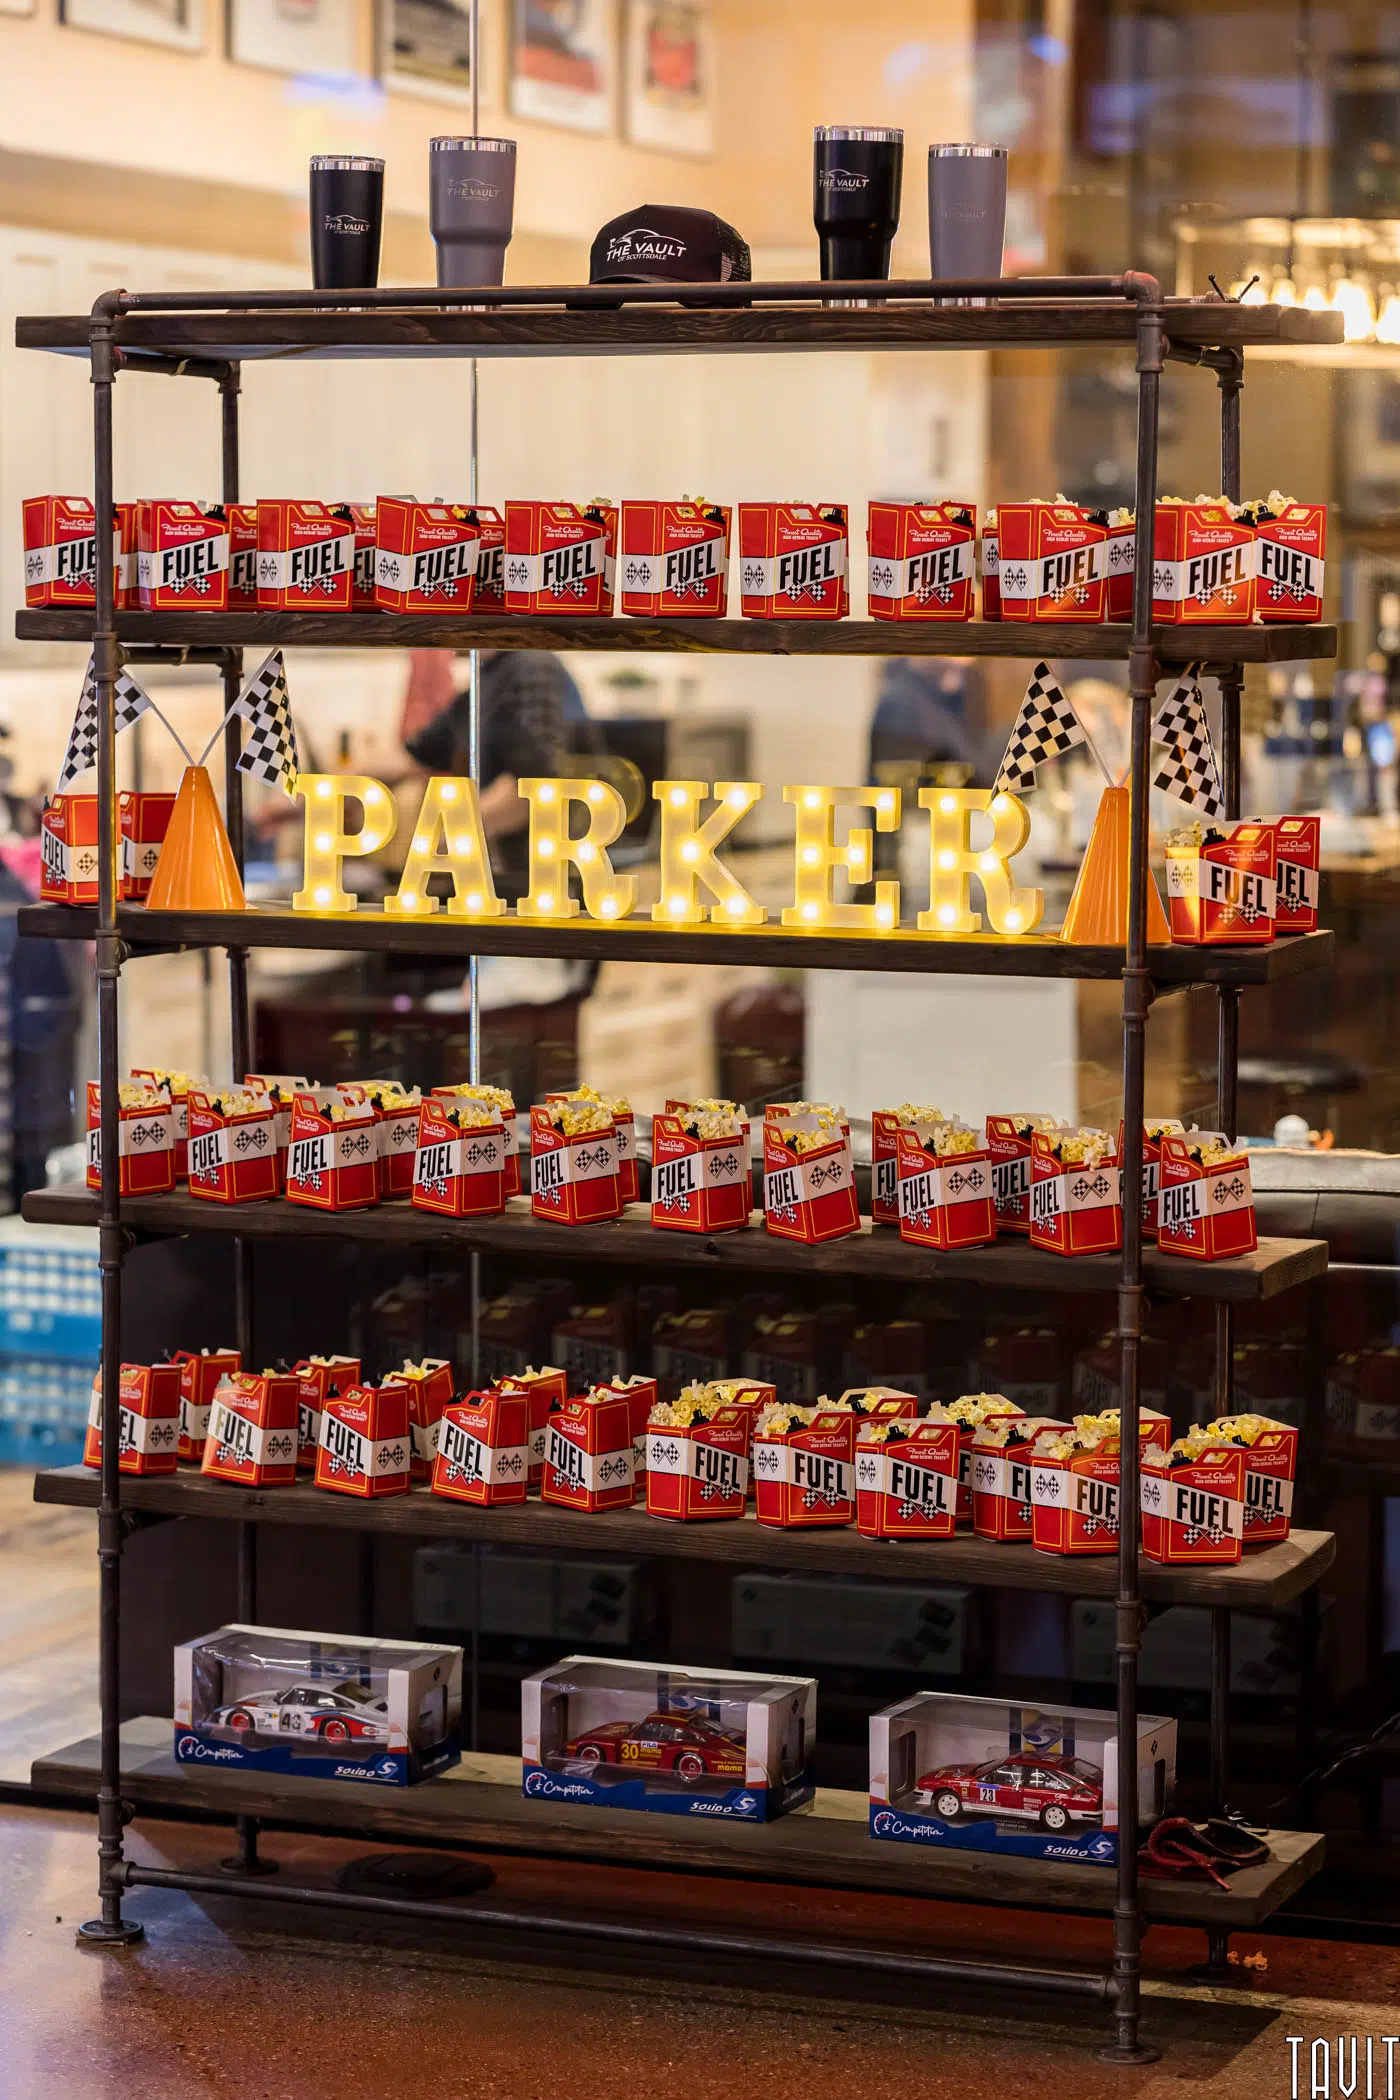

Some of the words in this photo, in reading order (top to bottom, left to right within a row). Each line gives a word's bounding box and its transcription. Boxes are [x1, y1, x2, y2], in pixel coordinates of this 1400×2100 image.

[471, 188, 500, 196] VAULT
[837, 179, 870, 188] VAULT
[607, 244, 631, 262] THE
[636, 243, 686, 257] VAULT
[58, 536, 95, 576] FUE
[164, 541, 218, 583] FUEL
[292, 540, 345, 583] FUEL
[414, 545, 468, 587] FUEL
[543, 544, 596, 586] FUEL
[666, 543, 716, 587] FUEL
[780, 546, 834, 590] FUEL
[908, 548, 962, 592] FUEL
[1043, 548, 1098, 593] FUEL
[1189, 548, 1245, 594] FUEL
[1262, 543, 1314, 592] FUEL
[44, 830, 66, 876] FUEL
[293, 773, 1044, 934] PARKER
[1211, 865, 1267, 913] FUEL
[192, 1134, 222, 1170] FUEL
[293, 1139, 327, 1175] FUEL
[419, 1144, 453, 1181] FUEL
[535, 1158, 563, 1191] FUEL
[657, 1159, 695, 1199] FUEL
[768, 1171, 798, 1207] FUEL
[878, 1161, 896, 1195] FU
[903, 1175, 934, 1212] FUEL
[1143, 1166, 1158, 1201] EL
[1034, 1180, 1059, 1218] FUEL
[1164, 1184, 1200, 1222] FUEL
[215, 1404, 253, 1457] FUEL
[300, 1406, 315, 1442] EL
[326, 1417, 364, 1469] FUEL
[444, 1423, 483, 1476] FUEL
[550, 1431, 585, 1484] FUEL
[696, 1446, 740, 1489] FUEL
[795, 1452, 847, 1496] FUEL
[892, 1462, 946, 1509] FUEL
[1247, 1474, 1284, 1512] UEL
[1077, 1478, 1116, 1518] FUE
[1176, 1488, 1233, 1534] FUEL
[621, 1744, 638, 1759] 30
[543, 1782, 594, 1797] Competition
[982, 1789, 994, 1802] 23
[892, 1822, 944, 1837] Competition
